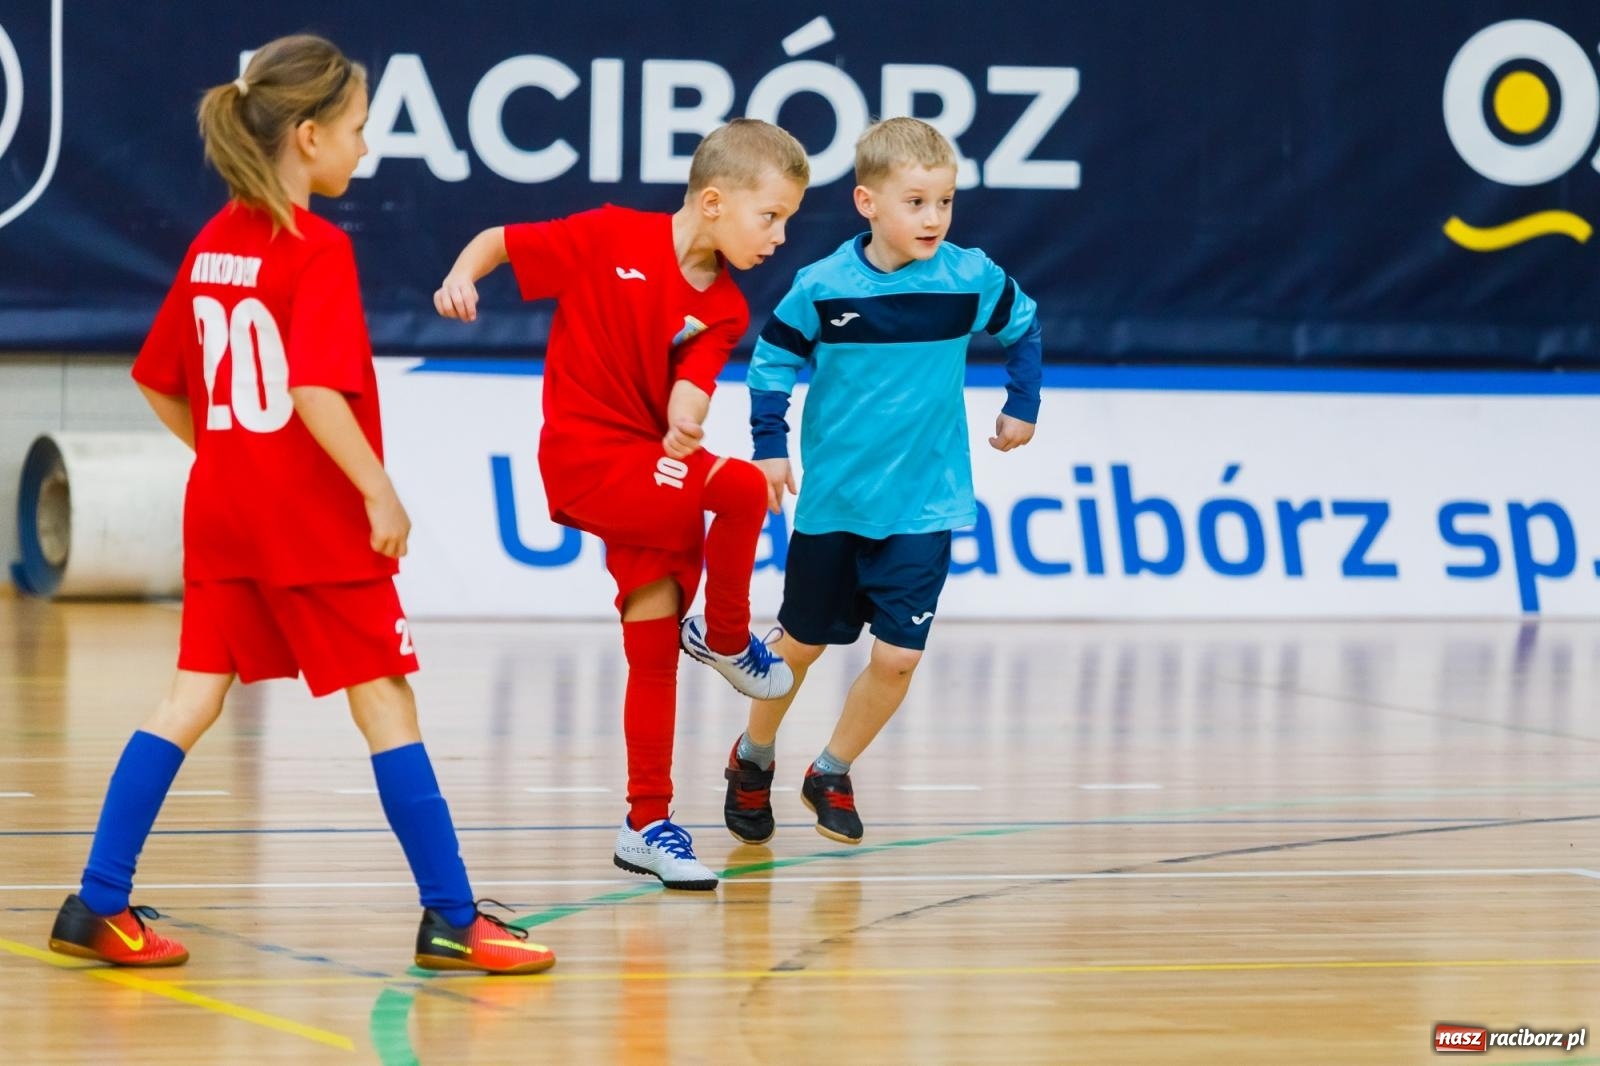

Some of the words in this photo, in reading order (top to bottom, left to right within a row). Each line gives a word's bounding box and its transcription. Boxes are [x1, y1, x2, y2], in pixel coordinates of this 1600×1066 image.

[239, 16, 1081, 190] ACIBÓRZ
[192, 295, 294, 433] 20
[653, 456, 689, 490] 10
[949, 464, 1399, 578] acibórz
